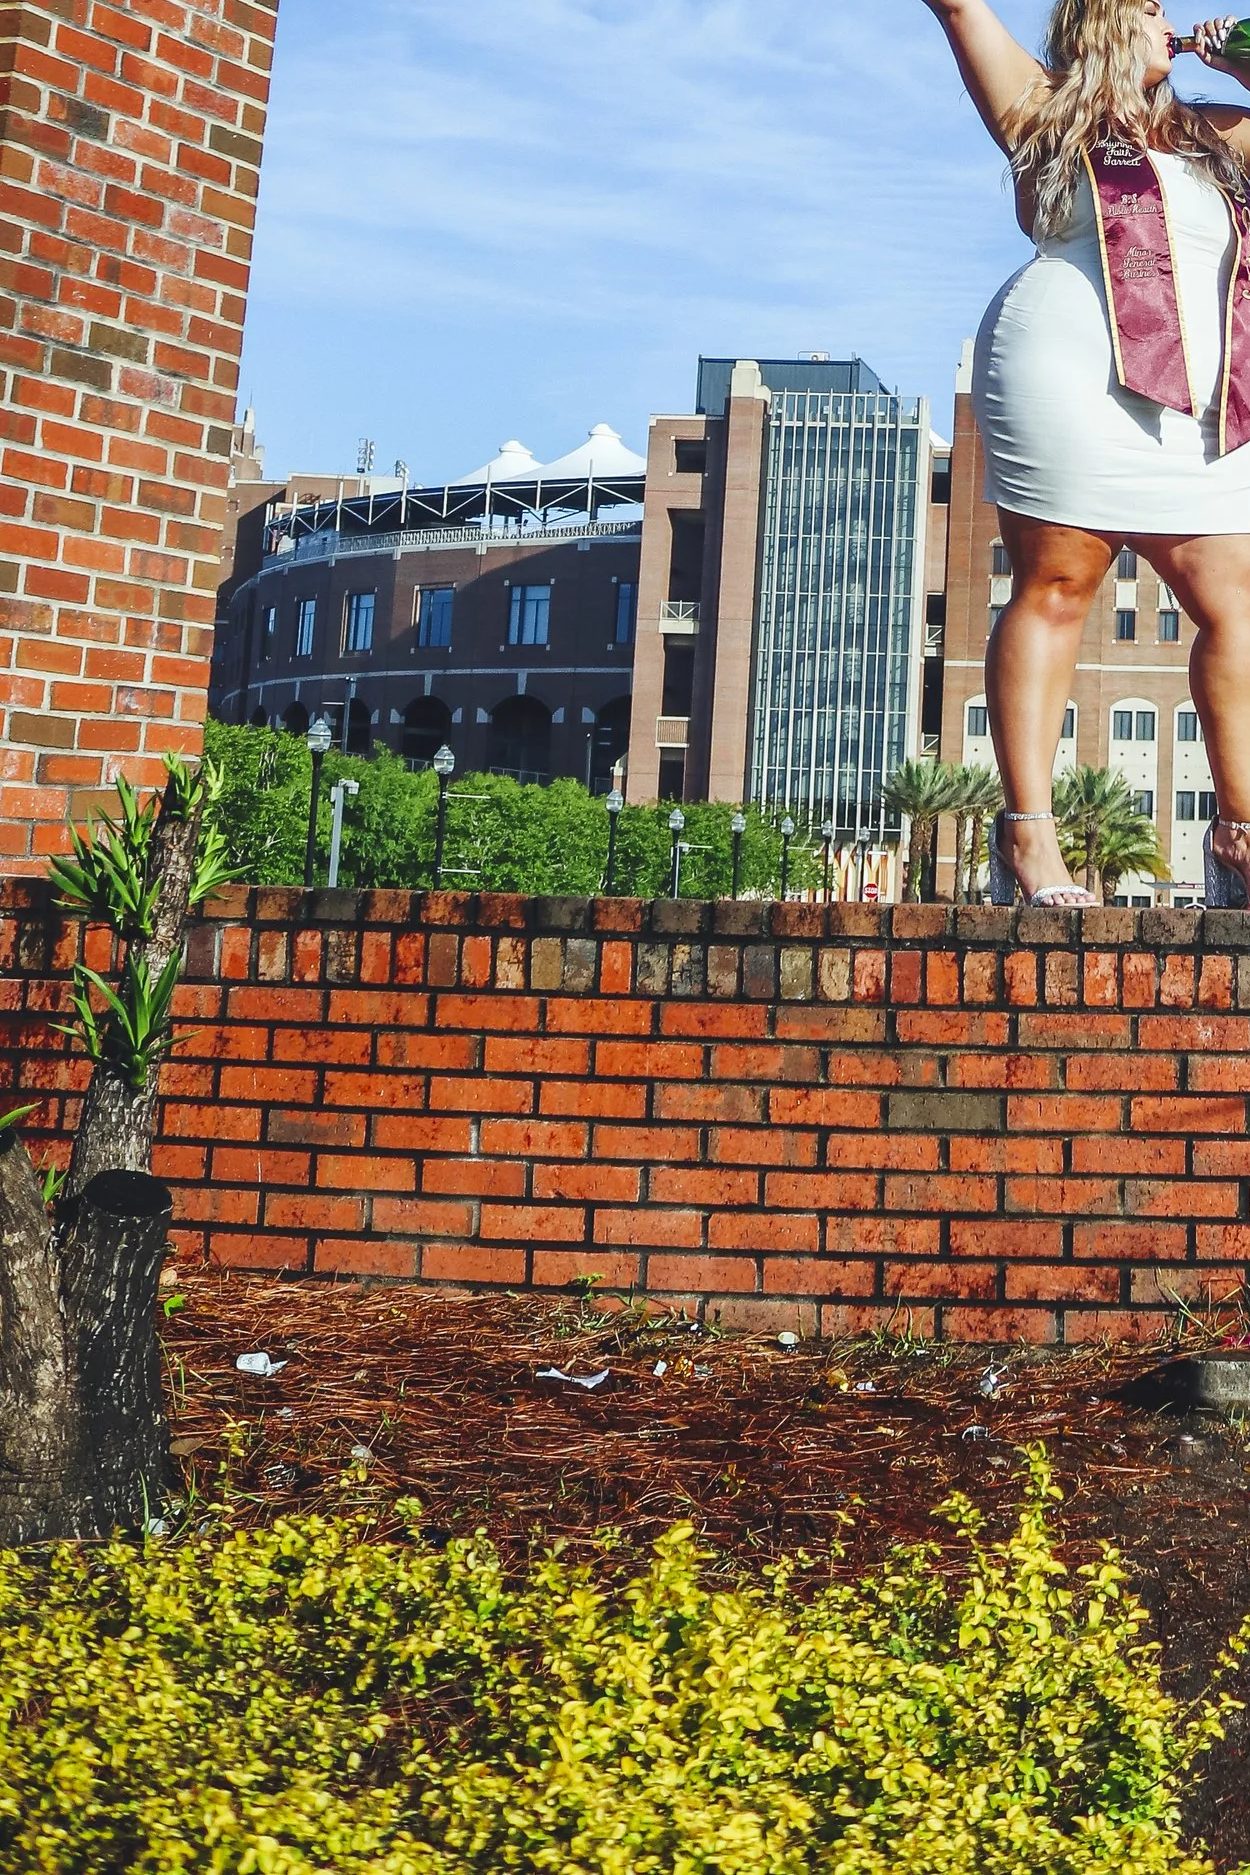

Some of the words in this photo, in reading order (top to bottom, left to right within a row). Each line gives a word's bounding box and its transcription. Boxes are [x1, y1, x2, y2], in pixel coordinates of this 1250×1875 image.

[1106, 148, 1133, 157] Faith
[1125, 245, 1152, 257] Minor
[1123, 257, 1157, 269] General
[1123, 268, 1160, 279] Business
